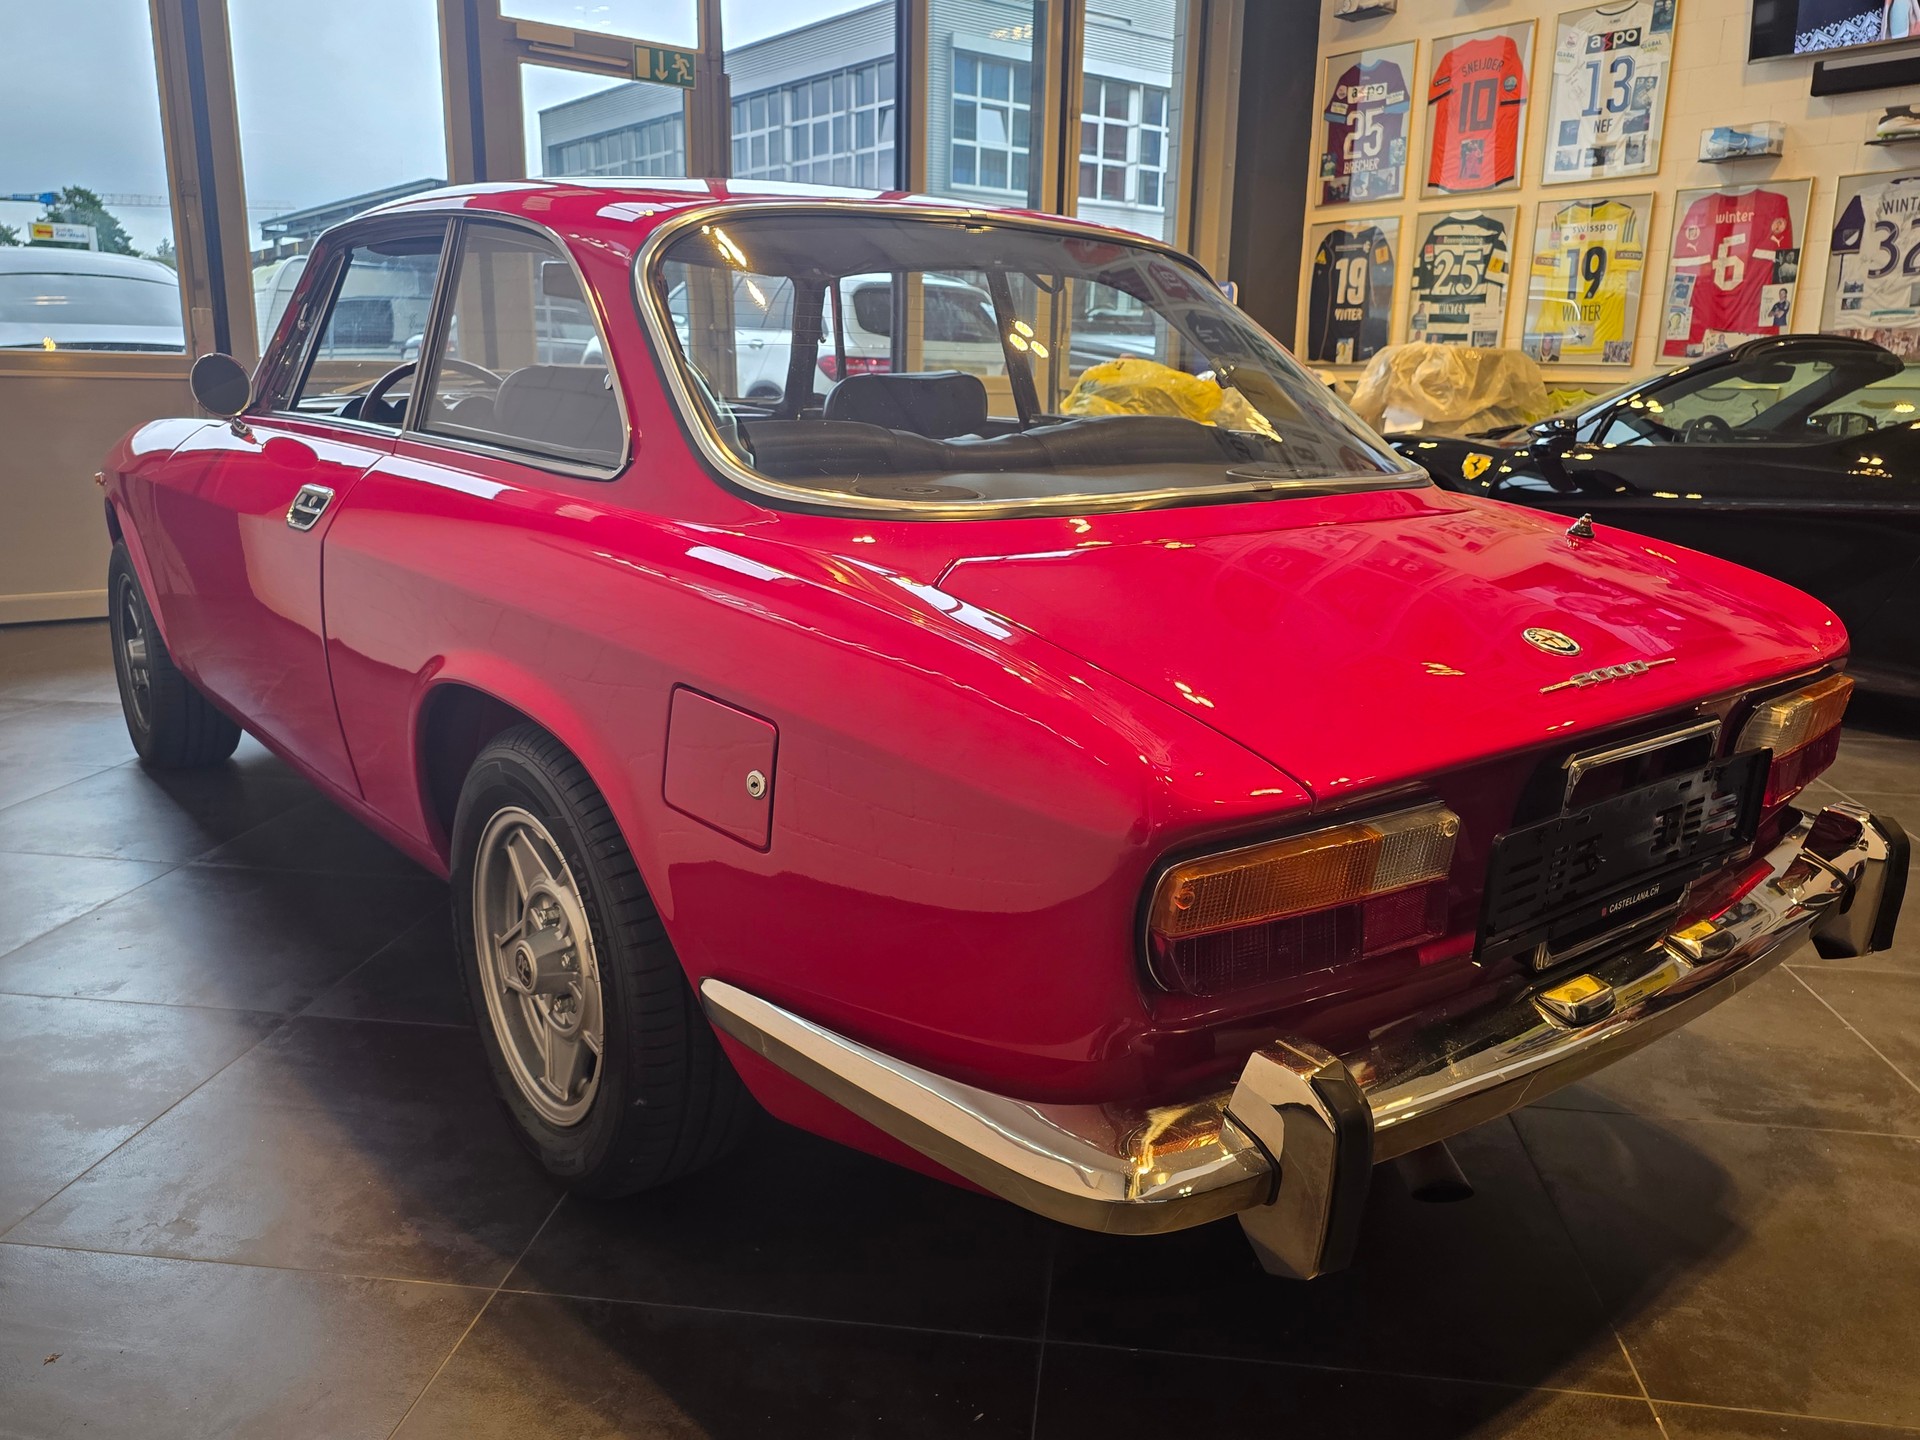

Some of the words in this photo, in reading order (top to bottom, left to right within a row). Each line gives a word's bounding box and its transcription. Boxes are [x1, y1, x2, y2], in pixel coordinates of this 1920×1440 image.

[1461, 57, 1504, 77] SNEIJDER
[1582, 55, 1635, 116] 13
[1458, 79, 1497, 133] 10
[1343, 106, 1384, 160] 25
[1594, 118, 1613, 134] NEF
[1716, 210, 1755, 224] winter
[1882, 196, 1920, 215] WINT
[1573, 223, 1618, 234] swisspor
[1712, 233, 1746, 291] 6
[1868, 219, 1920, 278] 32
[1335, 257, 1368, 305] 19
[1431, 250, 1482, 295] 25
[1567, 246, 1607, 300] 19
[1563, 304, 1601, 321] WINTER
[1570, 659, 1650, 689] 2000
[1609, 886, 1661, 914] CASTELLANA.CH
